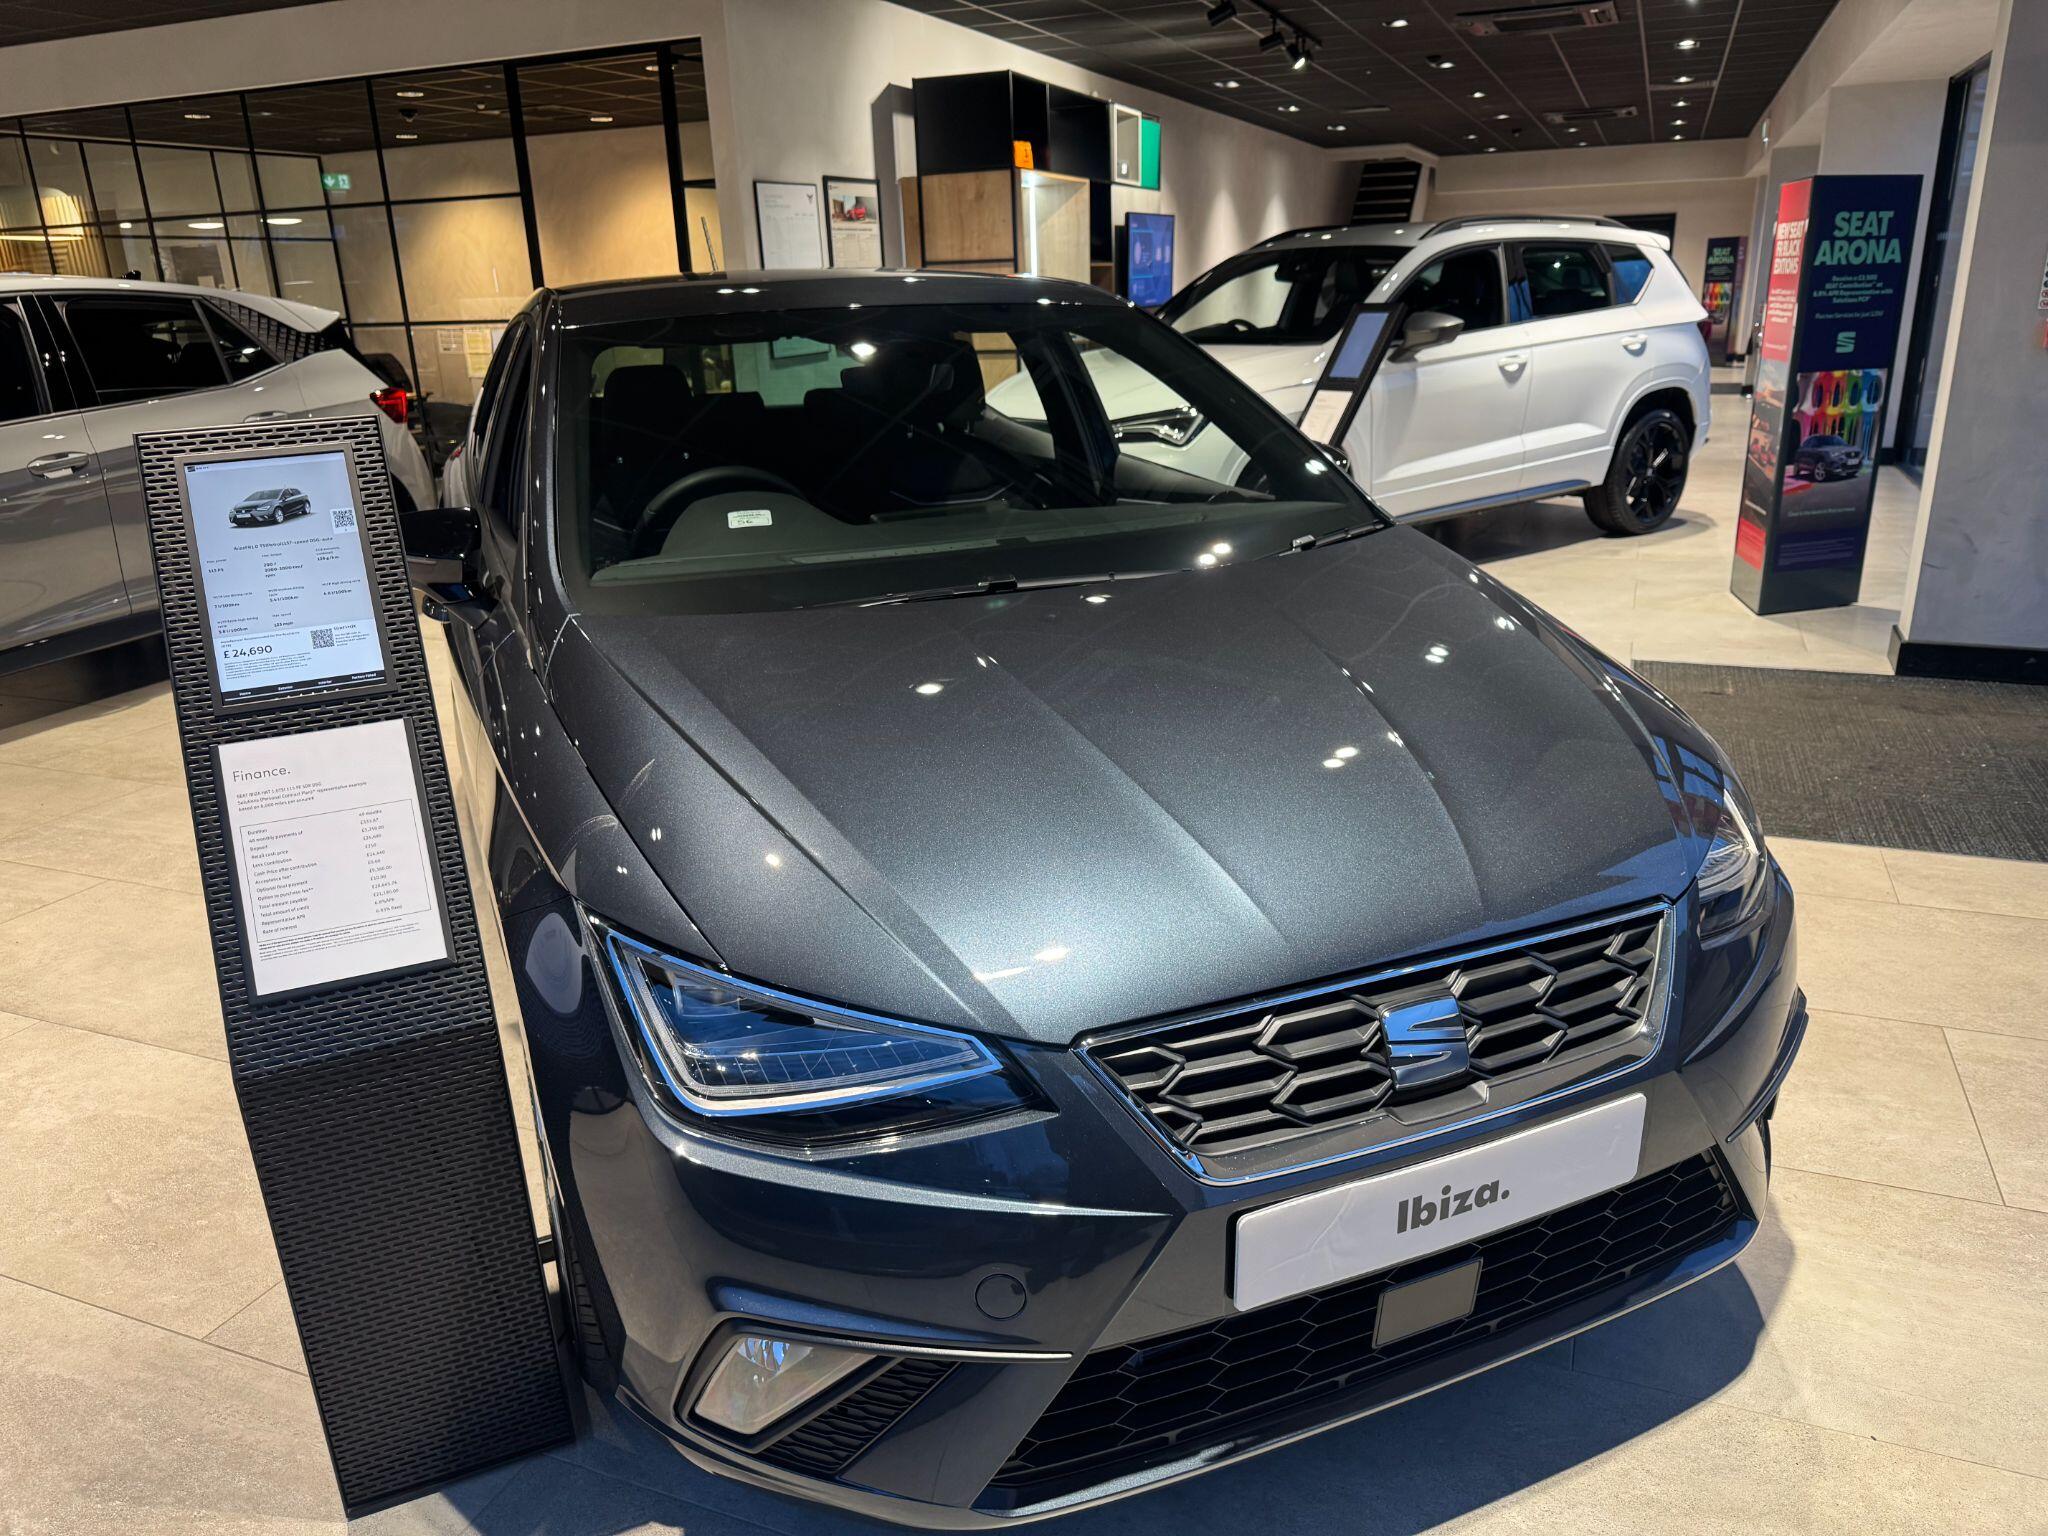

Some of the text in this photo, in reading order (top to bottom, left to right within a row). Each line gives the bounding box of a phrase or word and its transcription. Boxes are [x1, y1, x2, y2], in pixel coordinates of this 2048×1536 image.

[1789, 220, 1804, 238] SEAT
[1833, 211, 1894, 237] SEAT
[1814, 238, 1901, 266] ARONA
[1774, 257, 1799, 274] EDITIONS
[1840, 288, 1880, 296] Representative
[224, 645, 272, 658] £ 24,690
[232, 766, 291, 782] Finance.
[316, 784, 348, 793] representative
[264, 857, 292, 865] Contribution
[255, 876, 281, 884] Acceptance
[262, 916, 295, 925] Representative
[1396, 1179, 1510, 1234] Ibiza.
